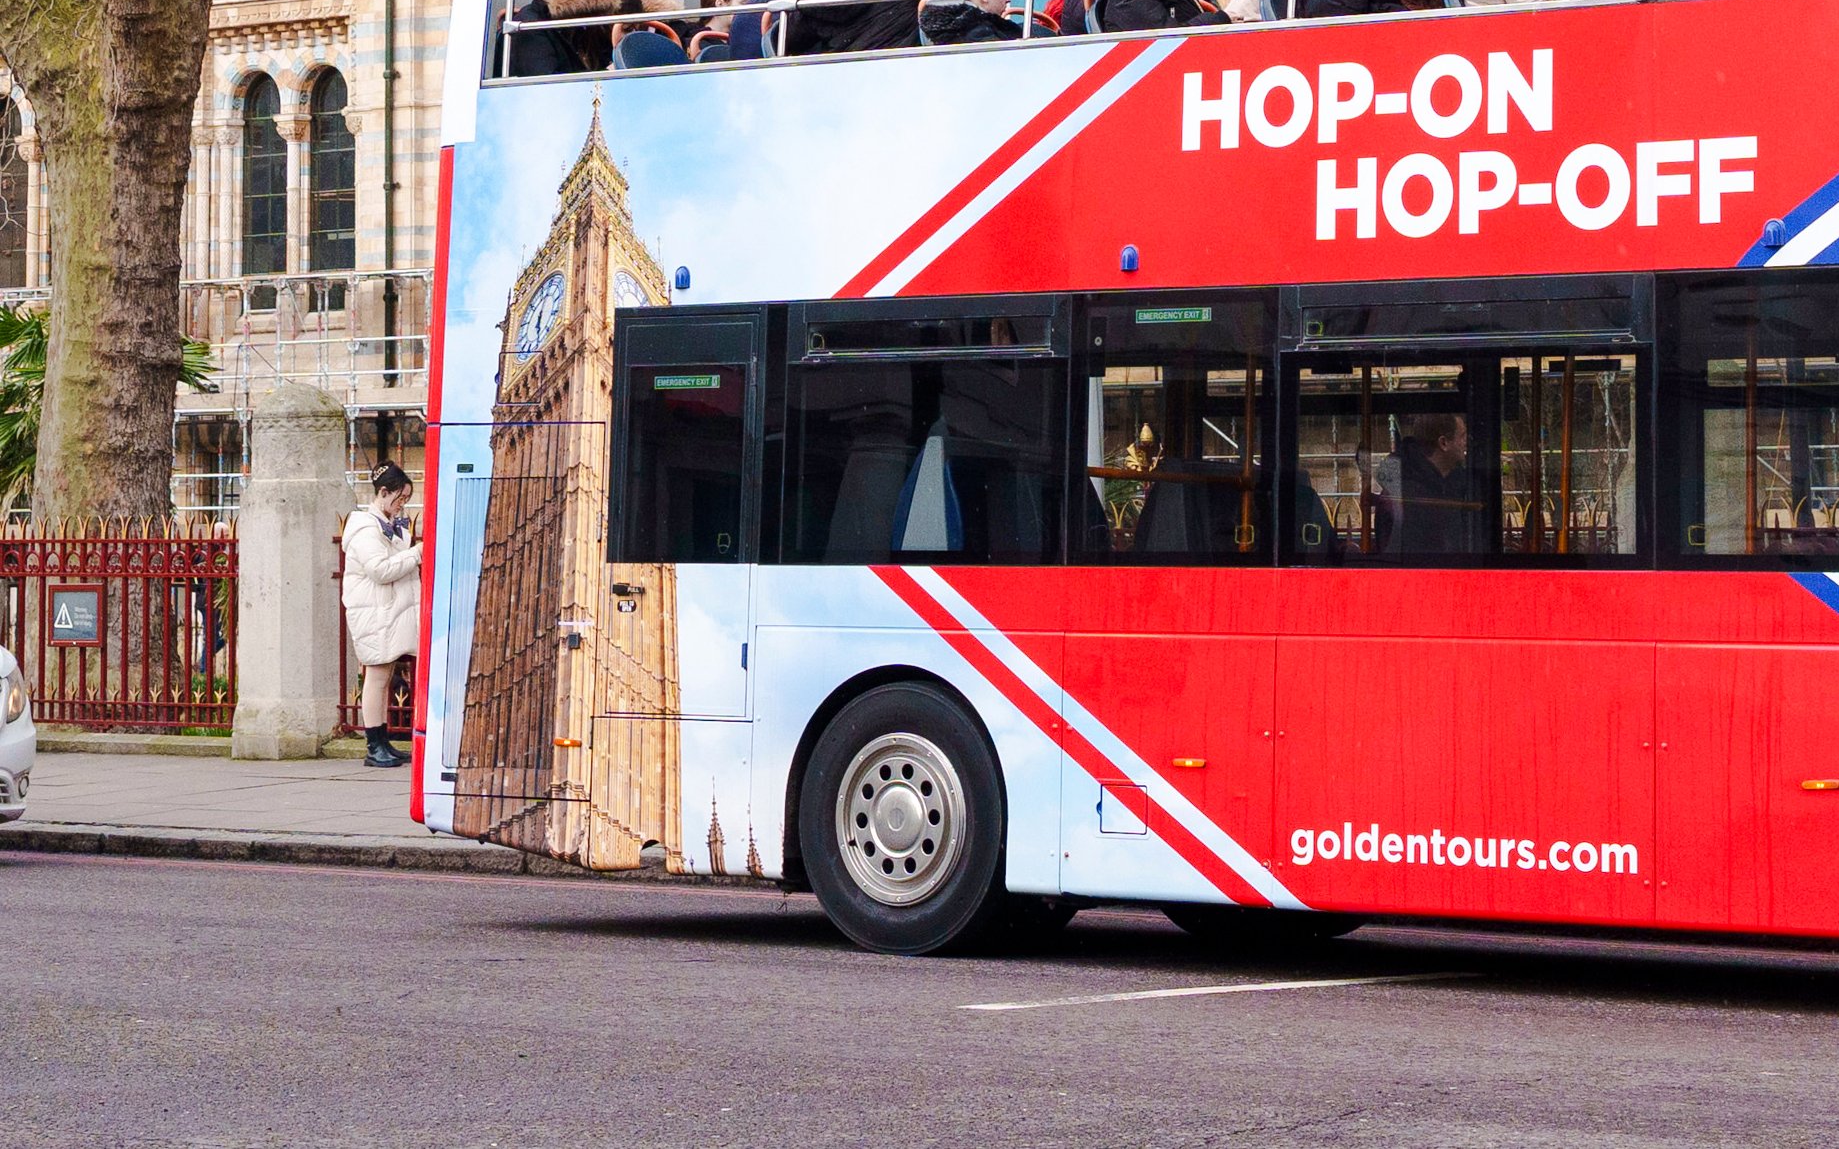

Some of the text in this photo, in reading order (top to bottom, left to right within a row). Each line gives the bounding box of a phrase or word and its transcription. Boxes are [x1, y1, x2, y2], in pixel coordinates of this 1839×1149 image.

[1181, 49, 1554, 151] HOP-ON
[1315, 136, 1758, 241] HOP-OFF
[1138, 310, 1200, 320] EMERGENCY EXIT
[656, 377, 710, 387] EMERGENCY EXIT
[1290, 822, 1638, 875] goldentours.com
